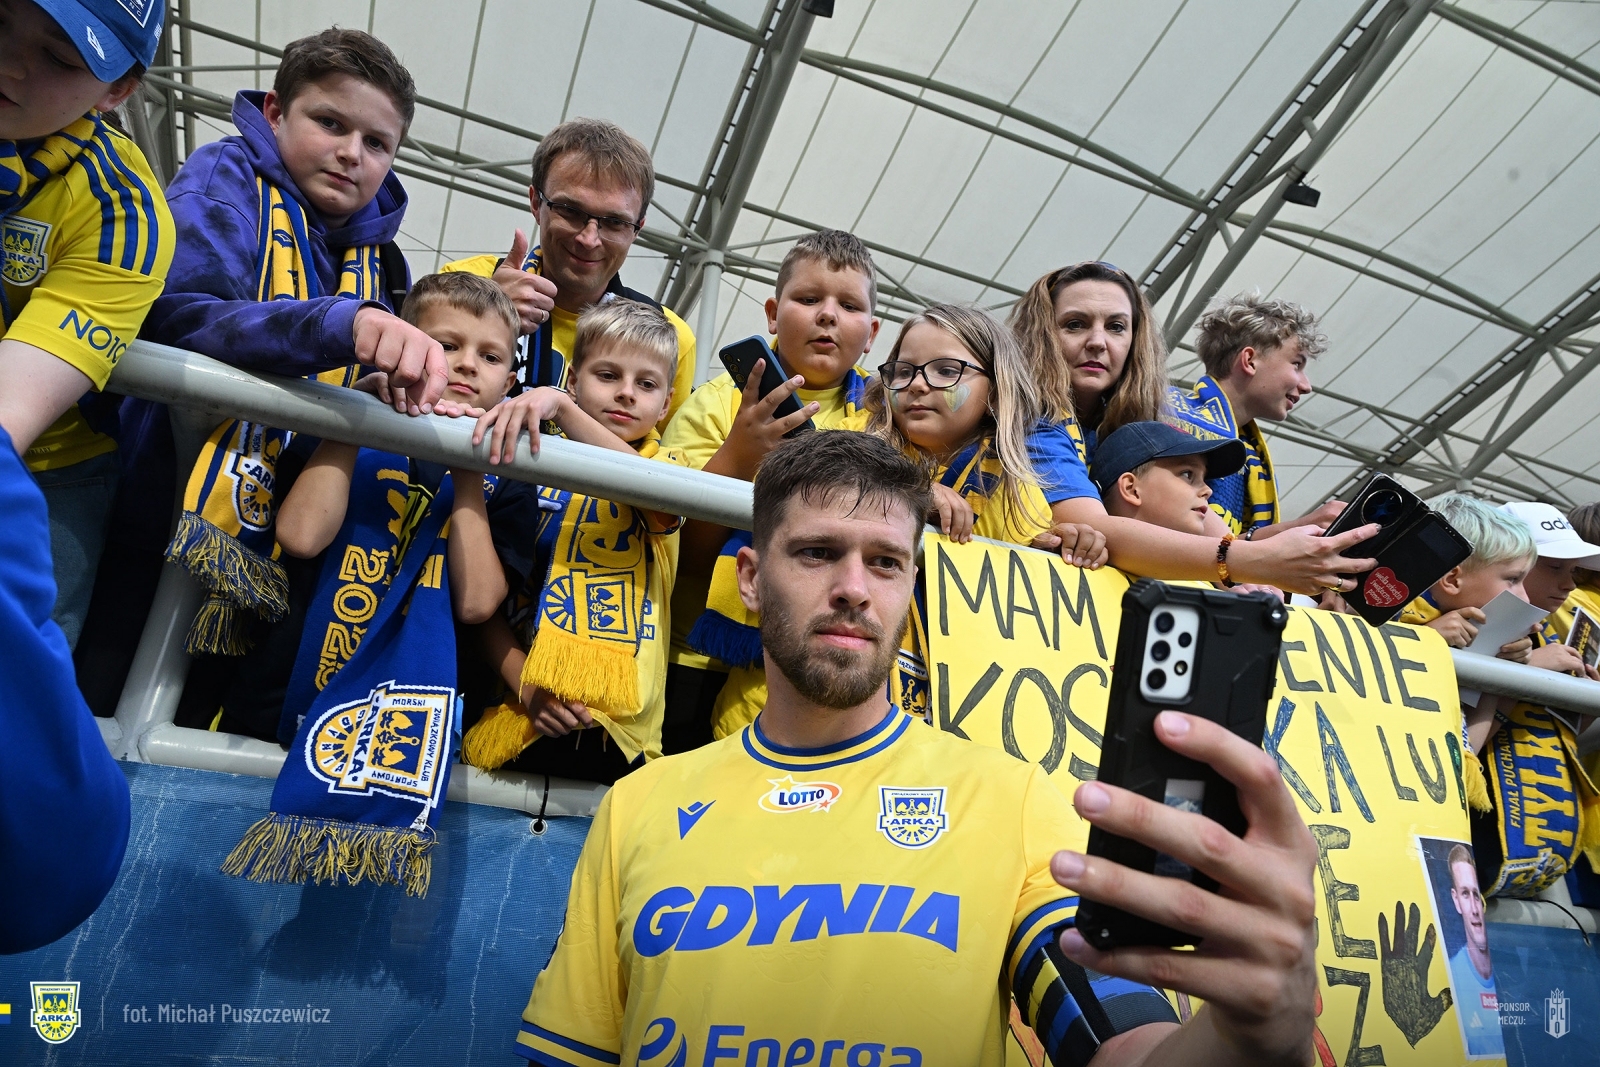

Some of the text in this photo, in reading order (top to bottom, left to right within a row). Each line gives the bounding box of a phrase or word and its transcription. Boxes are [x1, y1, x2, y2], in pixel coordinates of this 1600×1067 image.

[937, 542, 1108, 661] MAM
[1275, 605, 1441, 713] ENIE
[392, 698, 426, 707] MORSKI
[348, 705, 380, 776] ARKA
[421, 707, 442, 782] ZWIĄZKOWY KLUB
[371, 770, 418, 787] SPORTOWY
[778, 789, 825, 806] LOTTO
[890, 818, 935, 826] ARKA
[1507, 789, 1522, 829] FINAŁ
[633, 883, 960, 957] GDYNIA
